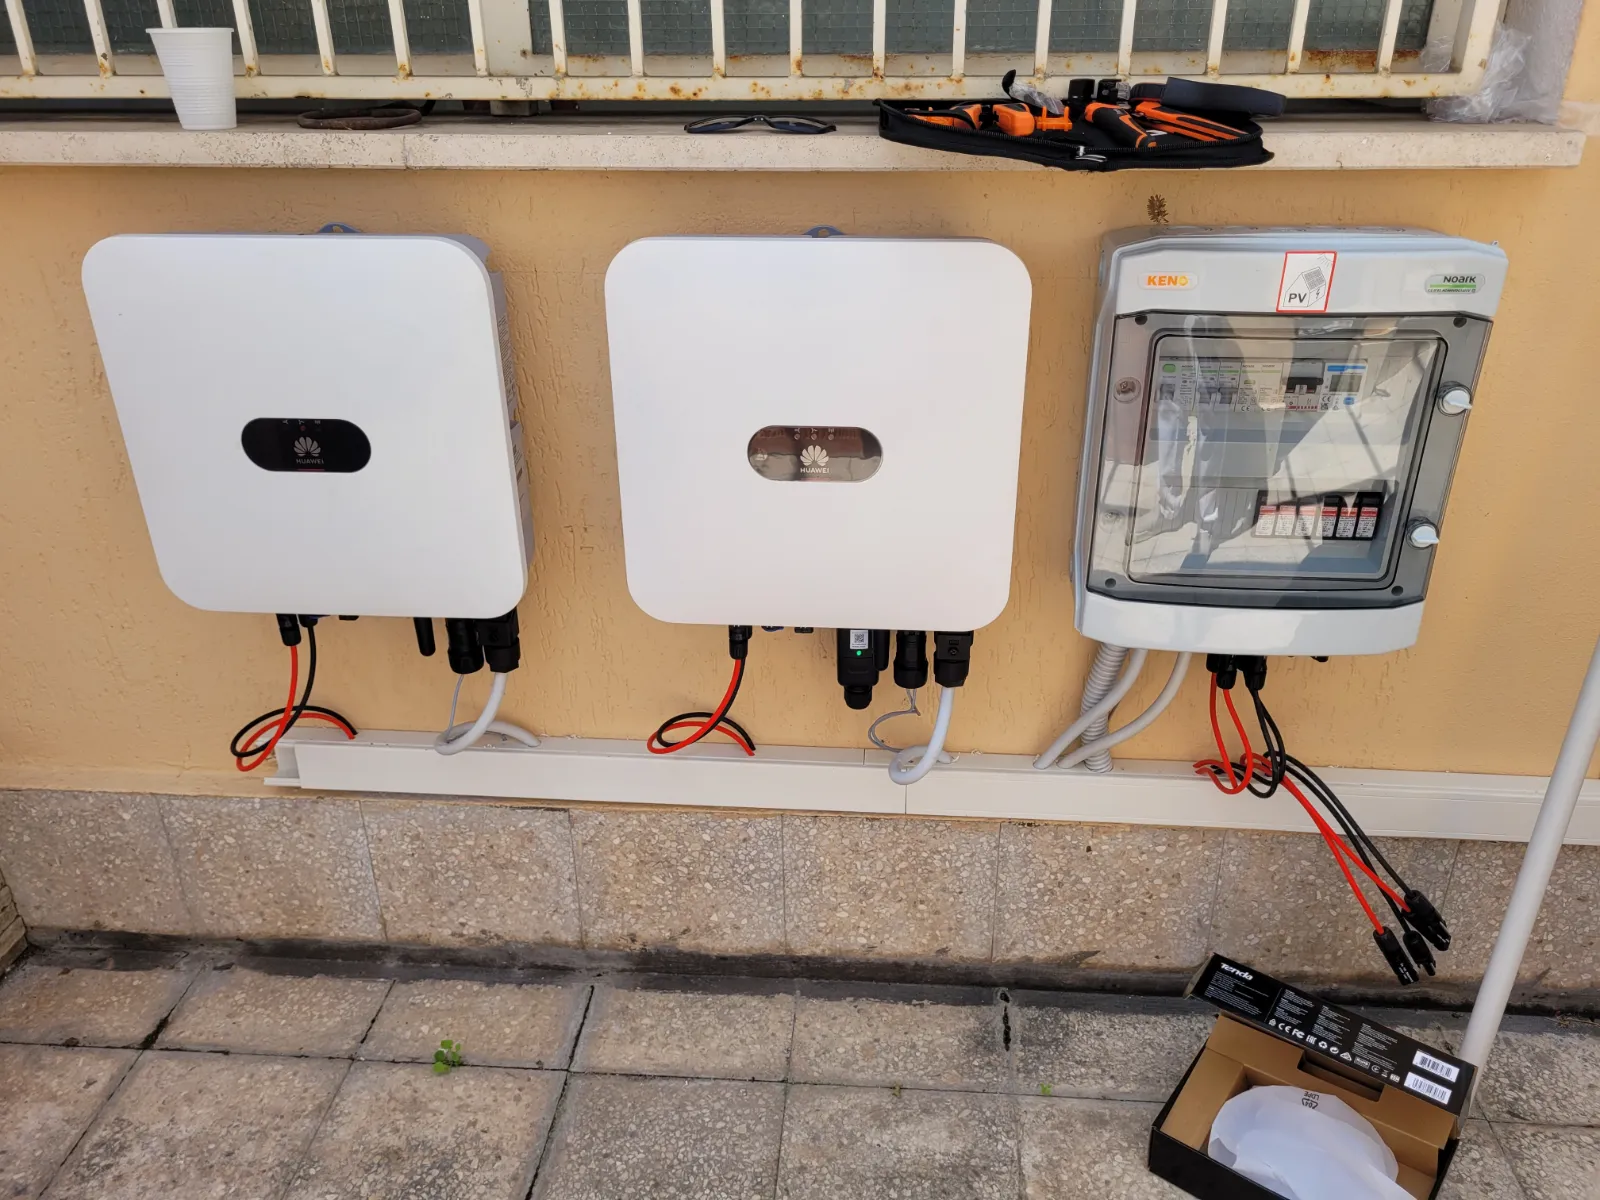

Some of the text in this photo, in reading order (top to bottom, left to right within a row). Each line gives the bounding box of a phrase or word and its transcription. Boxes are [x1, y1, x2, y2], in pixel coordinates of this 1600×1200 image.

[1147, 275, 1189, 287] KENO
[1288, 292, 1307, 304] PV
[1220, 961, 1254, 981] Tenda
